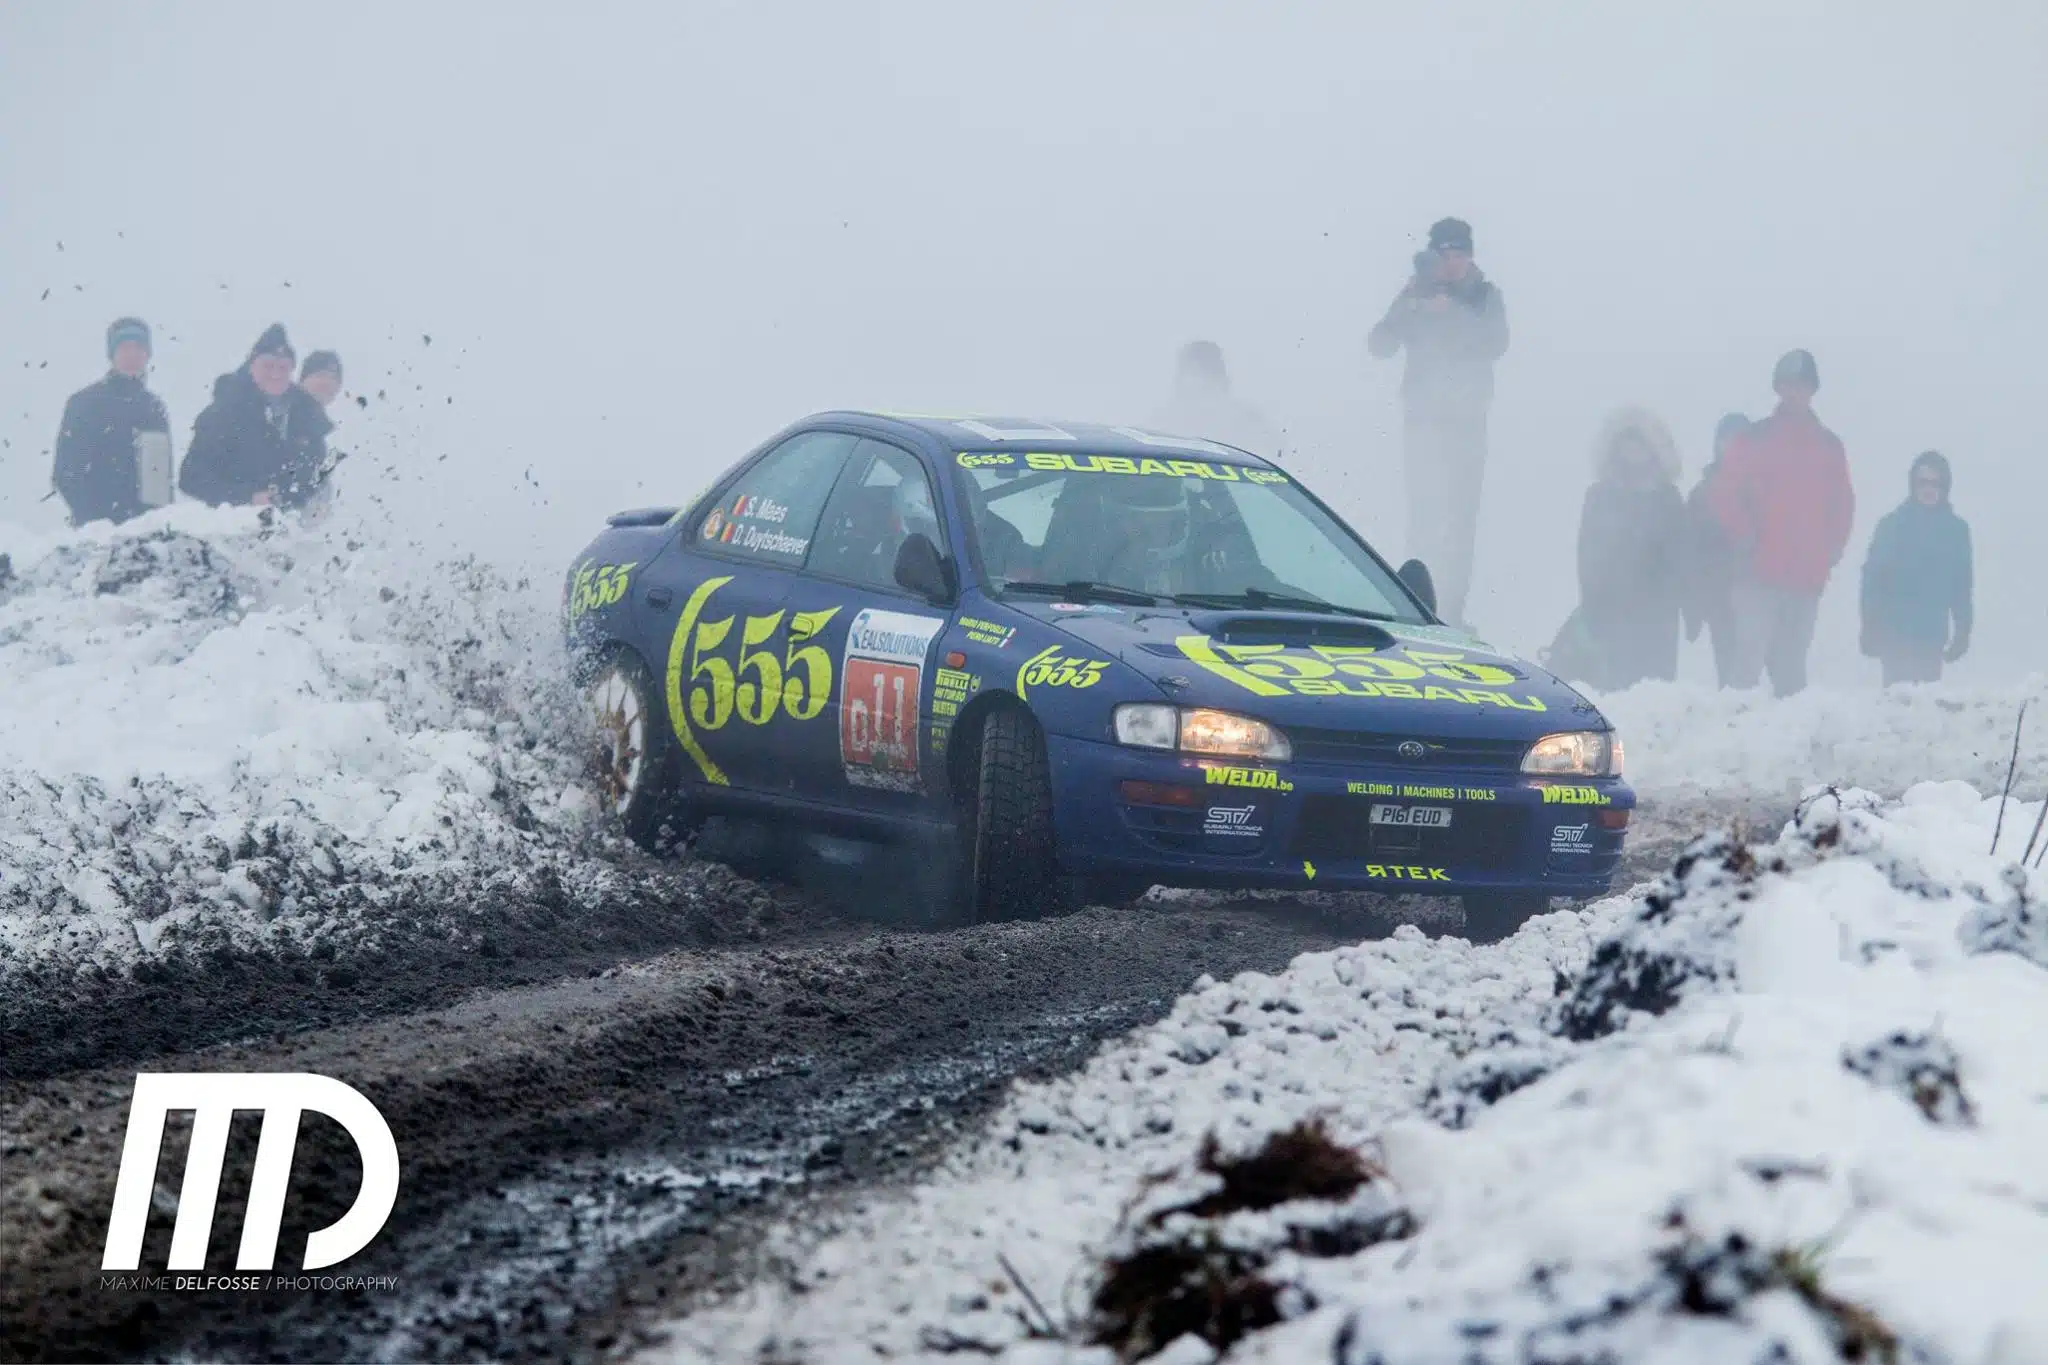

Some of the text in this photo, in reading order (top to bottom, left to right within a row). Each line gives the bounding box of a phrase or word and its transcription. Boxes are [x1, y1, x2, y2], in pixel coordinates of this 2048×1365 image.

[1024, 453, 1239, 481] SUBARU
[1288, 679, 1548, 712] SUBARU
[1205, 766, 1295, 792] WELDA.be
[1346, 782, 1393, 796] WELDING
[1403, 784, 1455, 799] MACHINES
[1465, 788, 1496, 801] TOOLS
[1412, 809, 1442, 825] EUD
[1204, 829, 1261, 837] INTERNATIONAL
